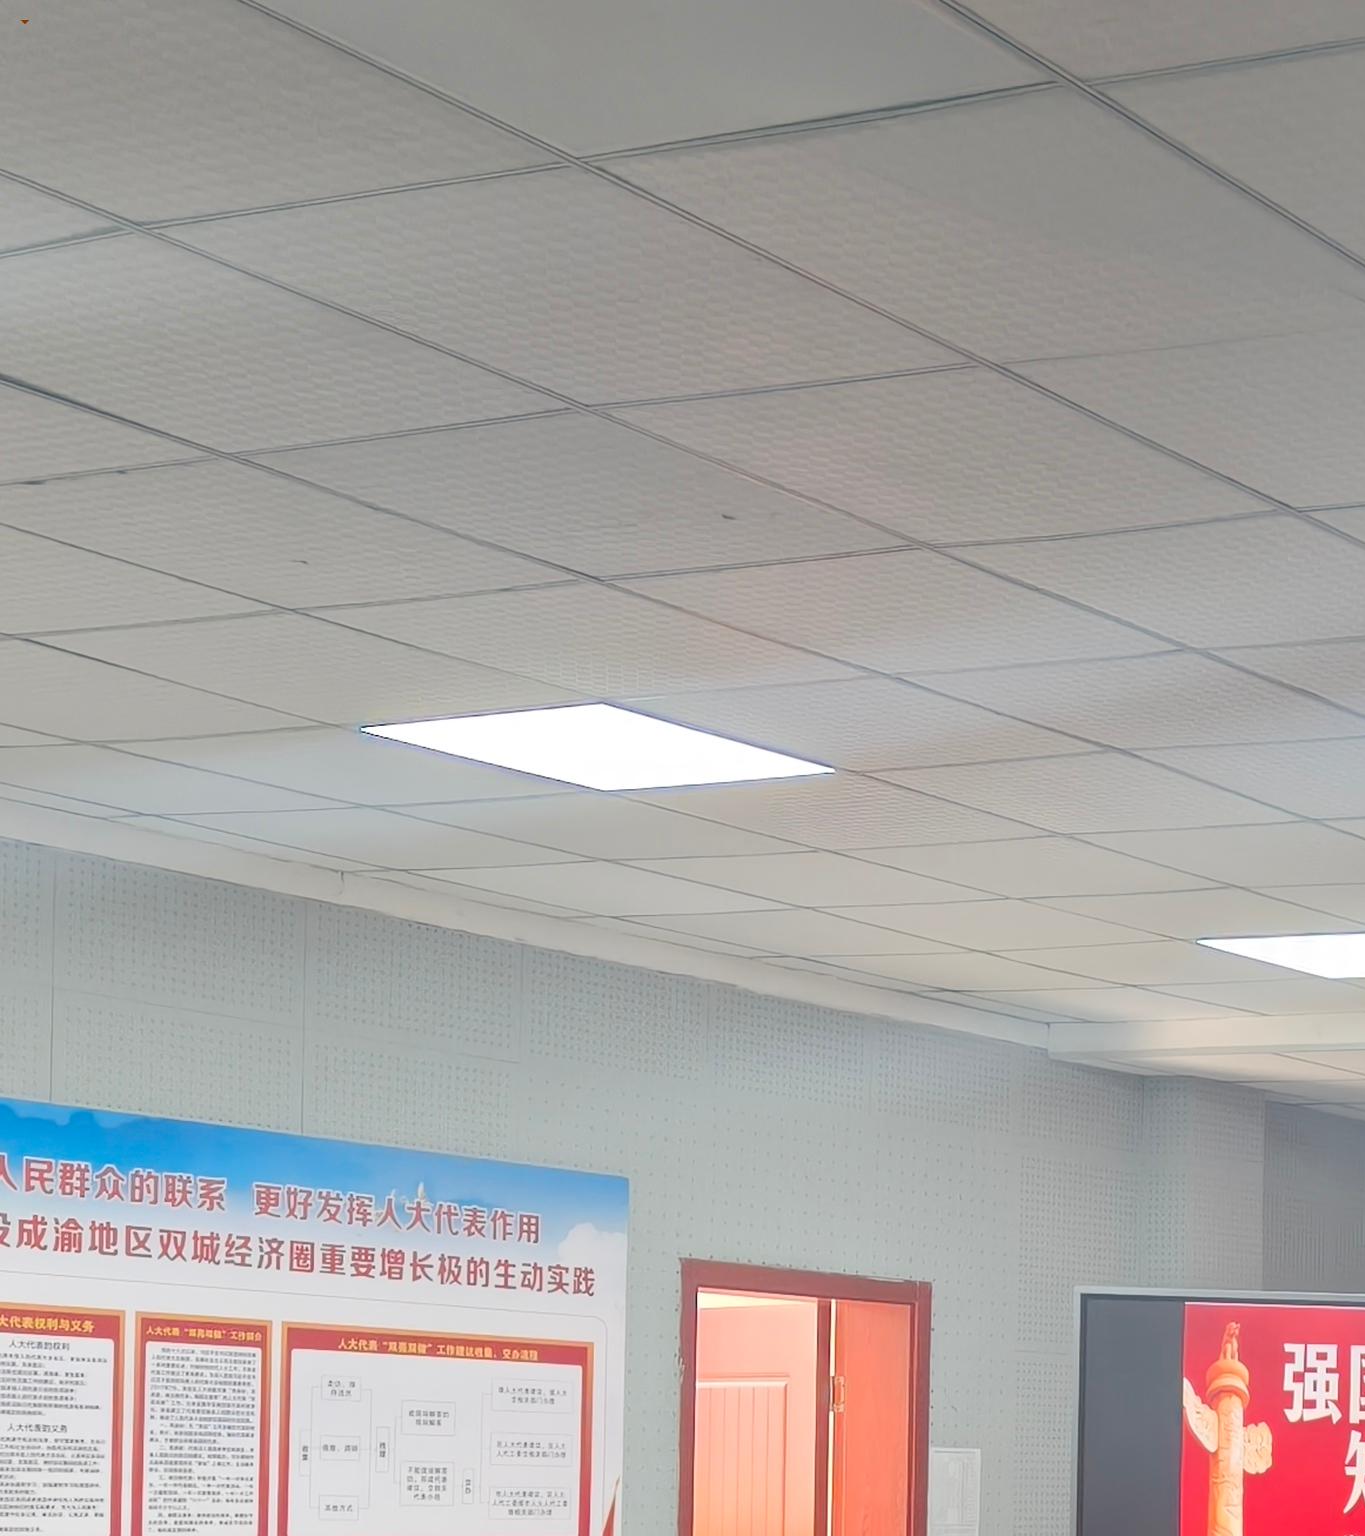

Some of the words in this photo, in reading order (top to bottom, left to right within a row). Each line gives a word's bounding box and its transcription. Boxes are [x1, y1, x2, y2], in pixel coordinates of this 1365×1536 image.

[254, 1183, 541, 1244] 更好发挥人大代表作用
